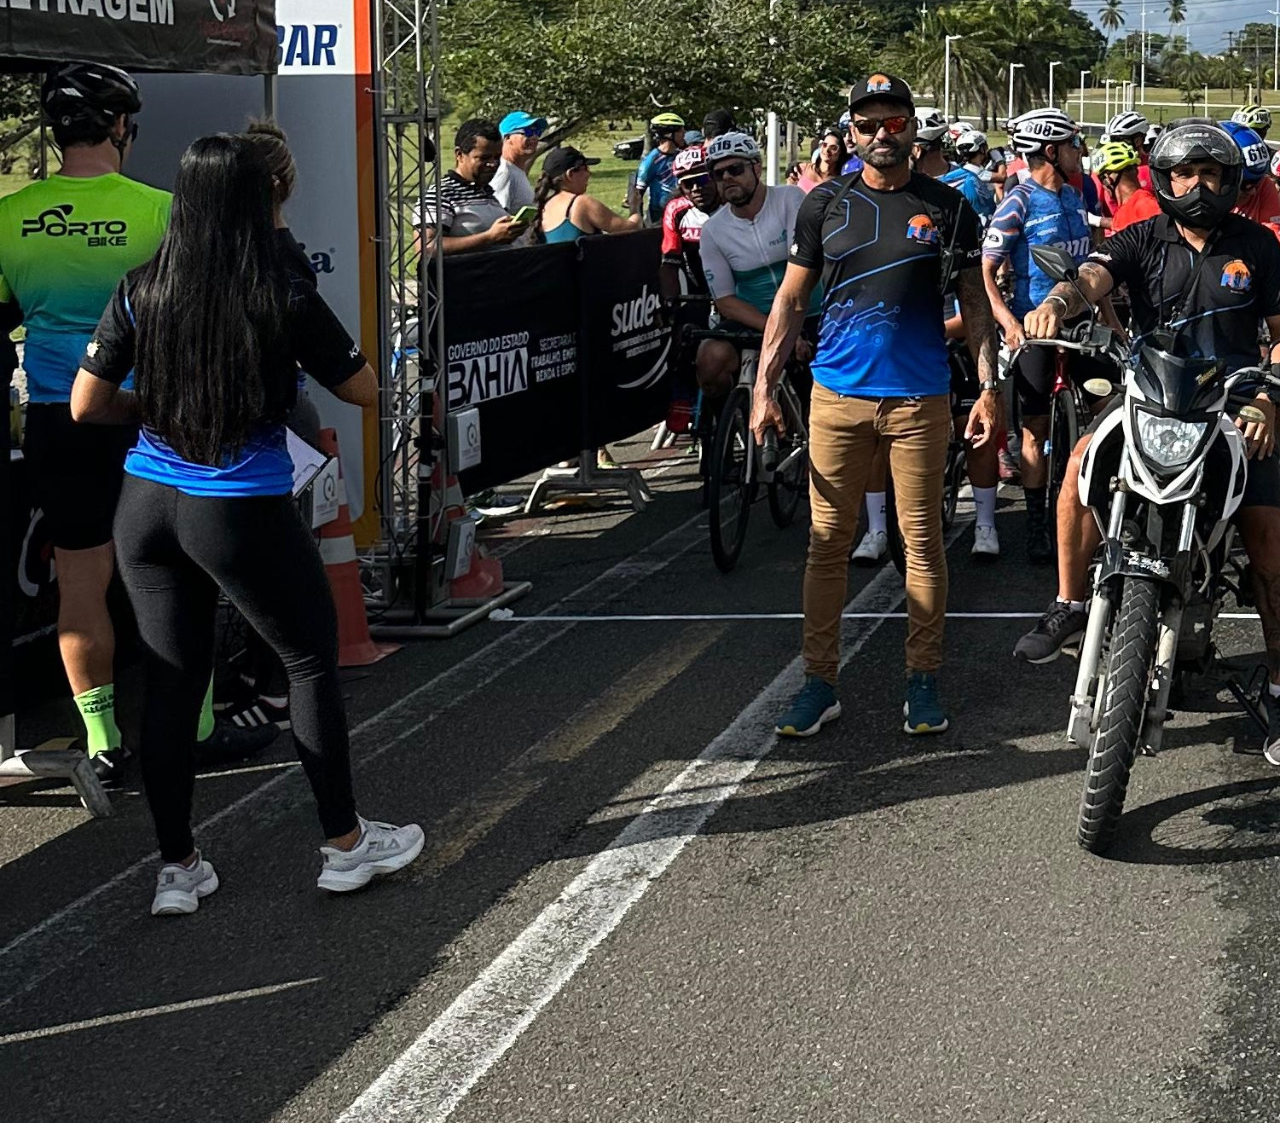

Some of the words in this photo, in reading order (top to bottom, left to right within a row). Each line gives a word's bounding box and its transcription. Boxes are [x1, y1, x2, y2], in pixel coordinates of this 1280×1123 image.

[1249, 147, 1269, 162] 619
[21, 219, 127, 237] PORTO
[87, 235, 128, 247] BIKE
[448, 340, 488, 361] GOVERNO
[488, 336, 500, 352] DO
[501, 331, 530, 350] ESTADO
